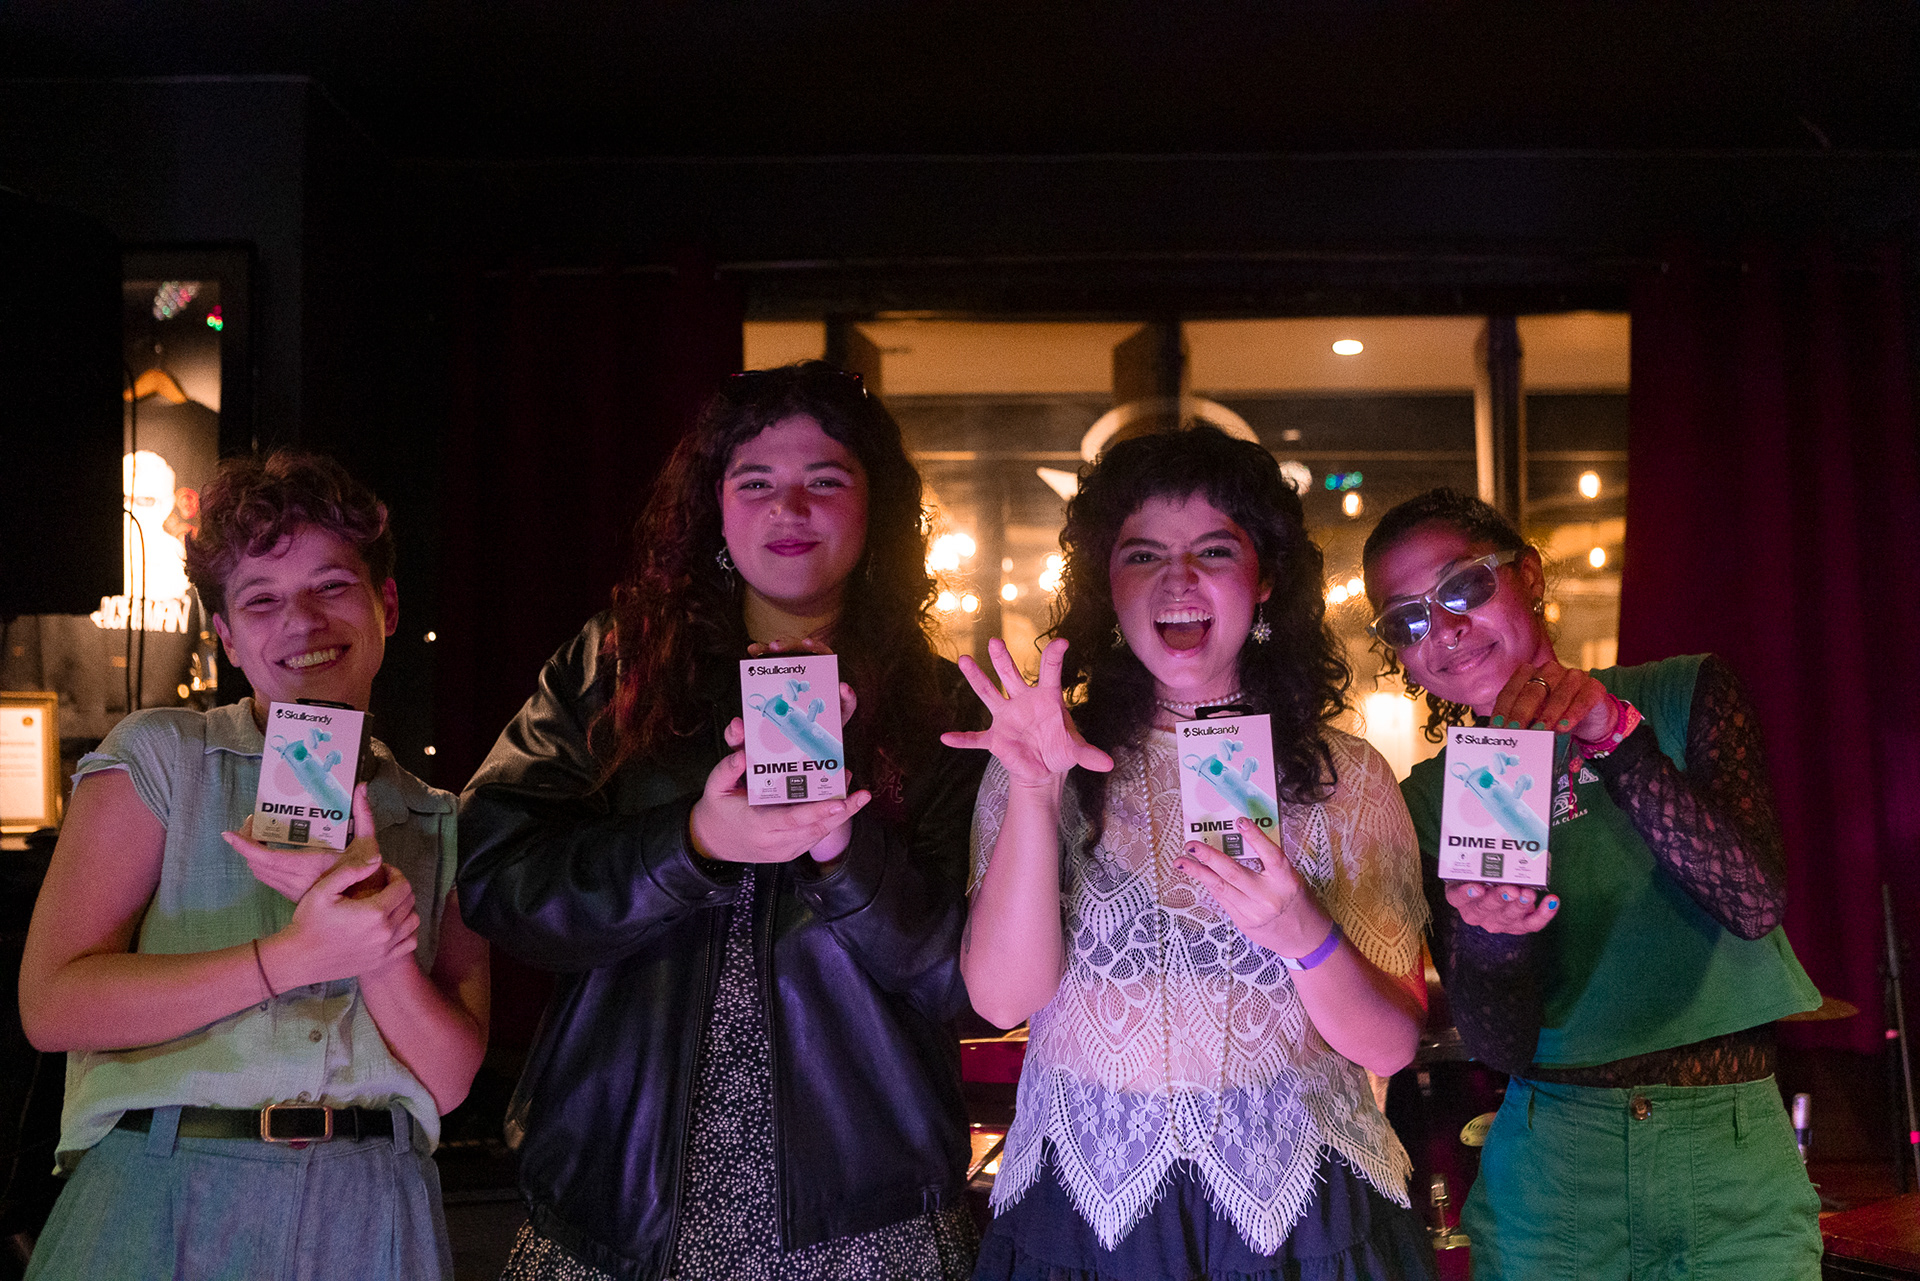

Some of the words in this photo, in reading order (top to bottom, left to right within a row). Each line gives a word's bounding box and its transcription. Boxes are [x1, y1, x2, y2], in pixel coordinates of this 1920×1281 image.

[757, 664, 806, 676] Skullcandy
[284, 709, 332, 725] Skullcandy
[1191, 725, 1240, 737] Skullcandy
[1464, 734, 1518, 748] Skullcandy
[753, 762, 798, 775] DIME
[802, 759, 838, 772] EVO
[261, 802, 305, 817] DIME
[308, 807, 343, 821] EVO
[1190, 820, 1234, 833] DIME
[1448, 836, 1496, 849] DIME
[1501, 839, 1540, 852] EVO
